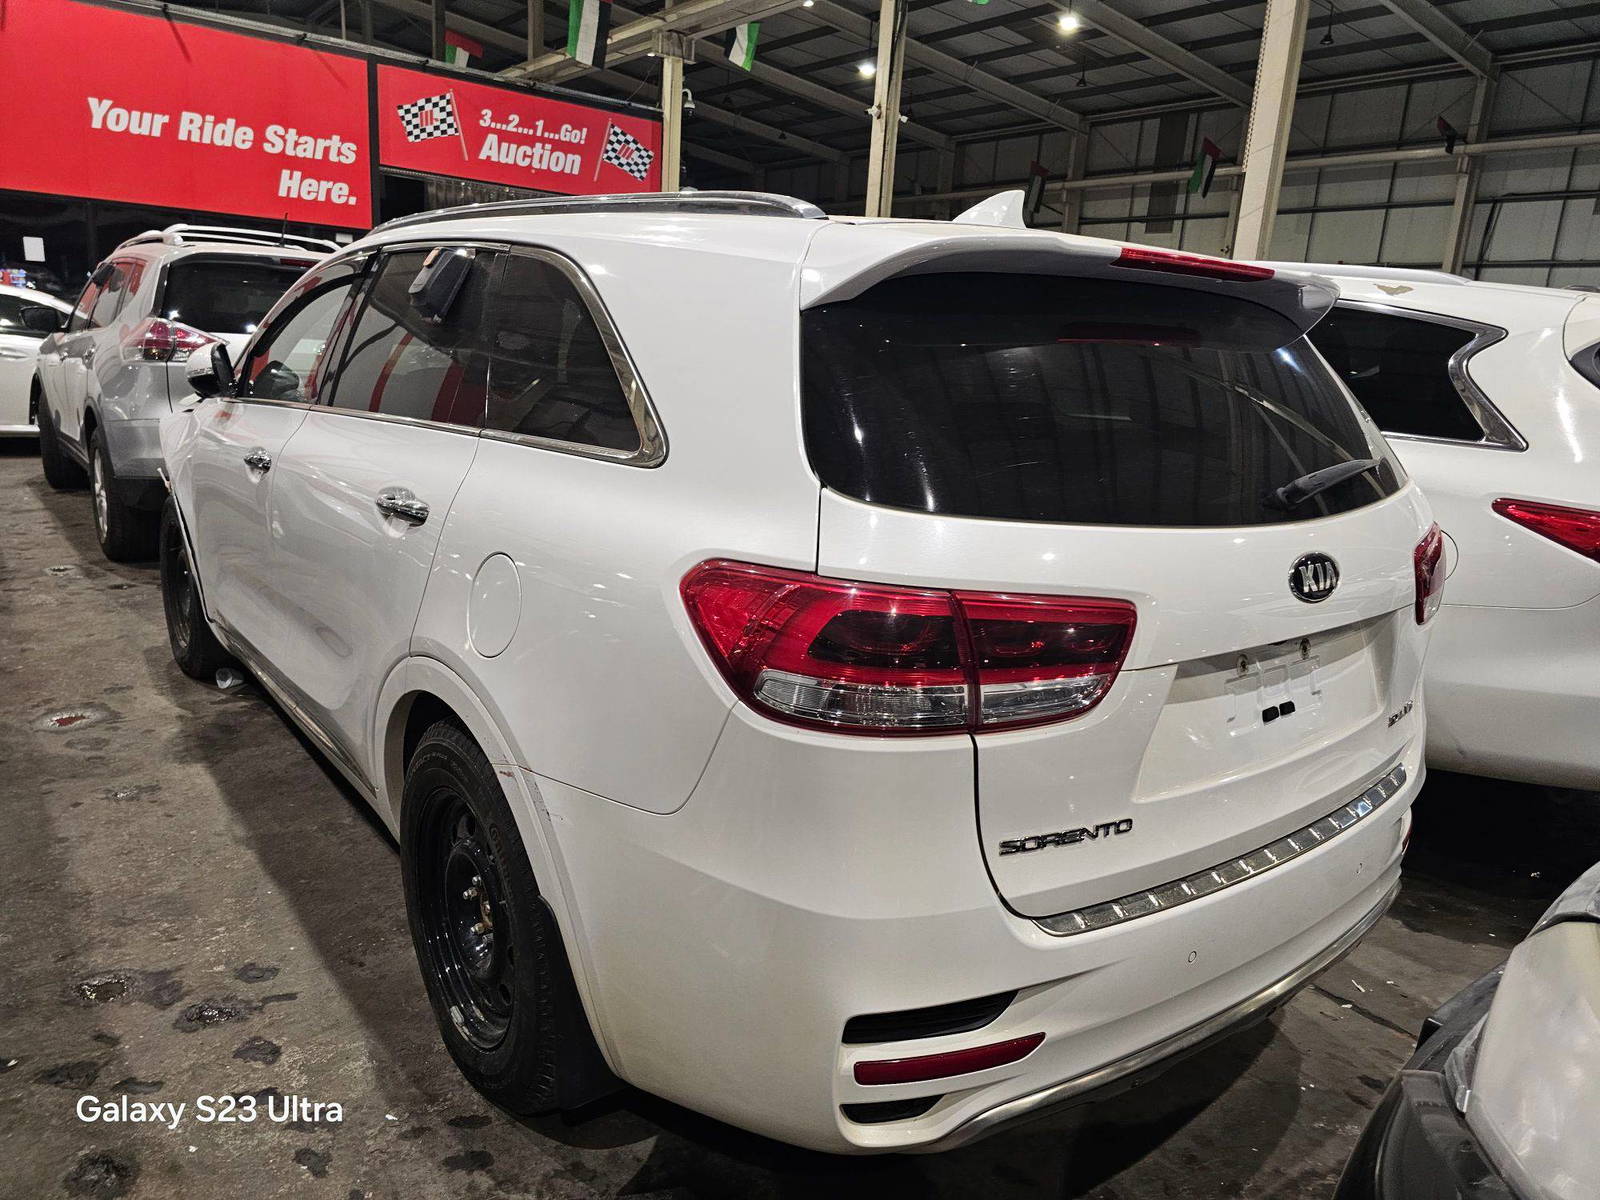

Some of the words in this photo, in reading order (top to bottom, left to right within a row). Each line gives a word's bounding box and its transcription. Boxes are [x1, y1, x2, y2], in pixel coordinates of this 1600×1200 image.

[87, 97, 169, 137] Your
[178, 111, 254, 150] Ride
[262, 125, 357, 164] Starts
[478, 133, 582, 175] Auction
[277, 169, 357, 205] Here.
[1299, 561, 1339, 593] KIA
[999, 818, 1133, 857] SORENTO
